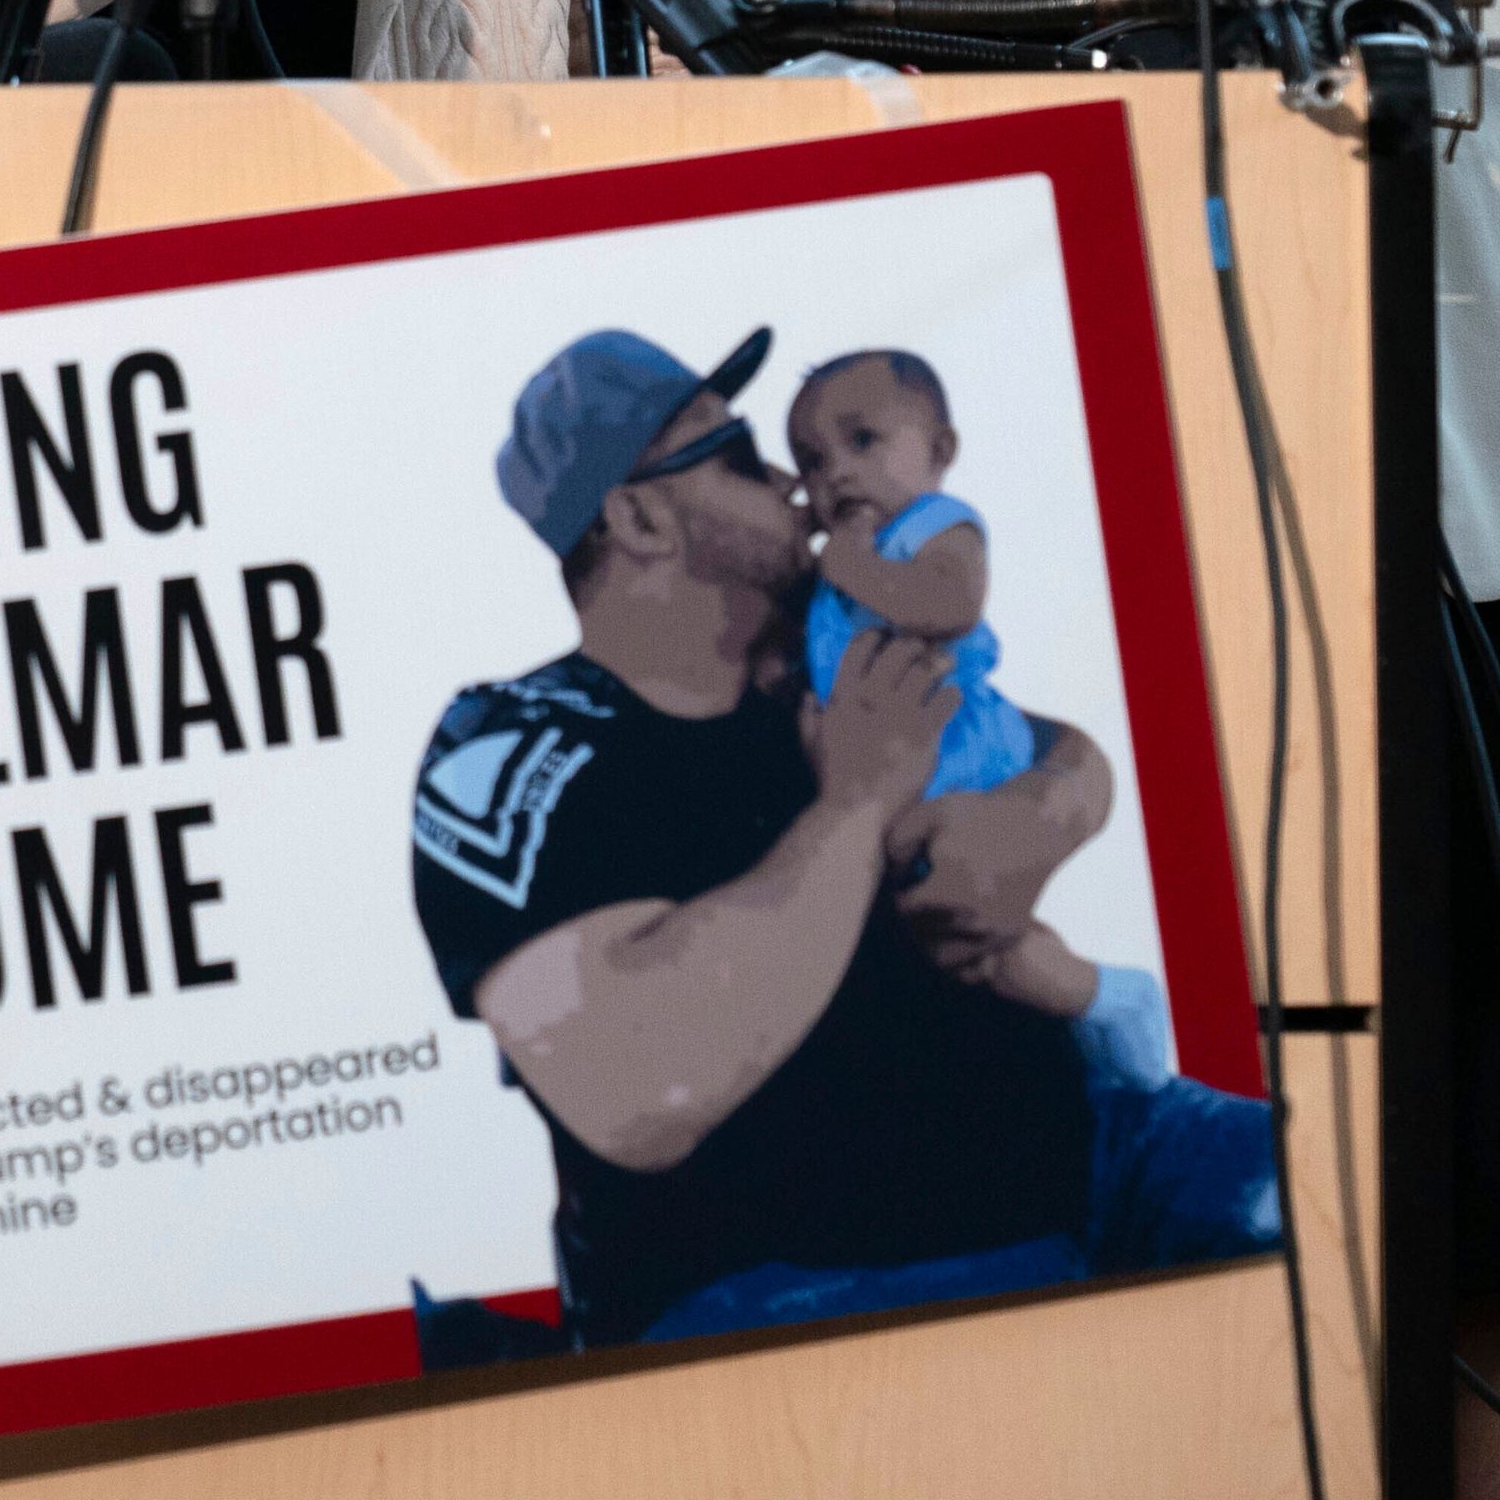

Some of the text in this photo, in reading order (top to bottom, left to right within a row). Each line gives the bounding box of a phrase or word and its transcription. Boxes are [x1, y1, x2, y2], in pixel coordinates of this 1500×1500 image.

[102, 1077, 131, 1116] &
[144, 1032, 440, 1113] disappeared
[130, 1095, 403, 1165] deportation
